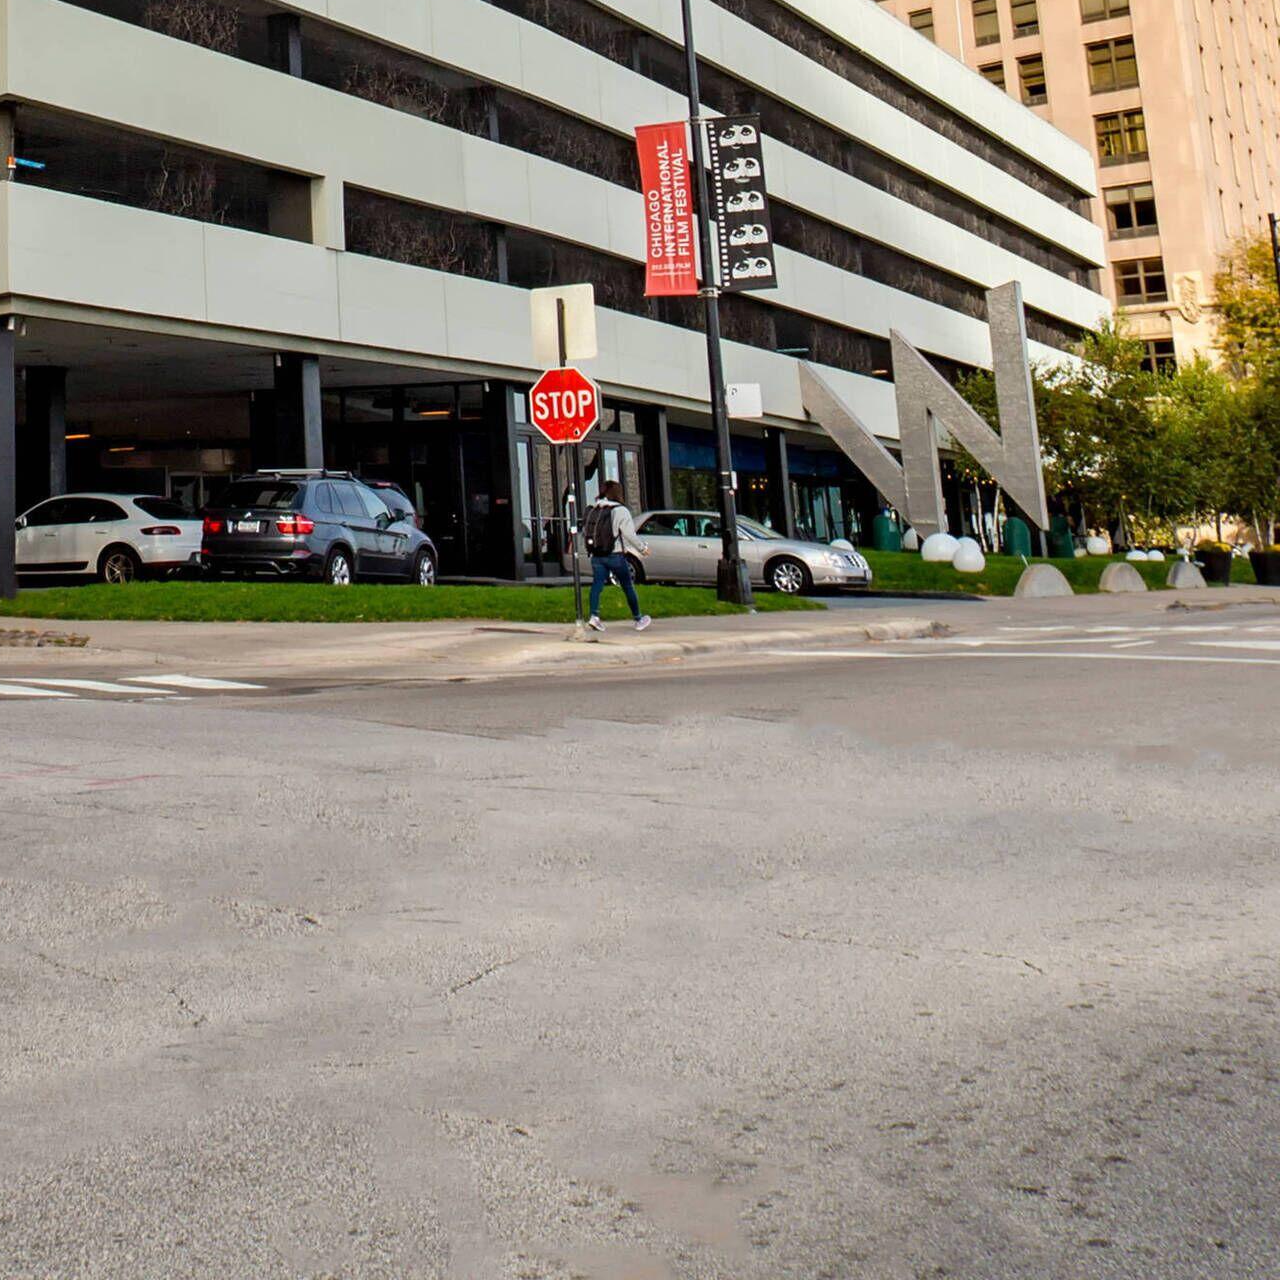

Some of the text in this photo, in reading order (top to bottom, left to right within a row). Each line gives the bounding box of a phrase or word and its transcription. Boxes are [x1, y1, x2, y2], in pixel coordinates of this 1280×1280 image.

[647, 190, 663, 258] CHICAGO
[656, 140, 675, 257] INTERNATIONAL
[671, 147, 690, 256] FILM FESTIVAL
[534, 389, 592, 420] STOP
